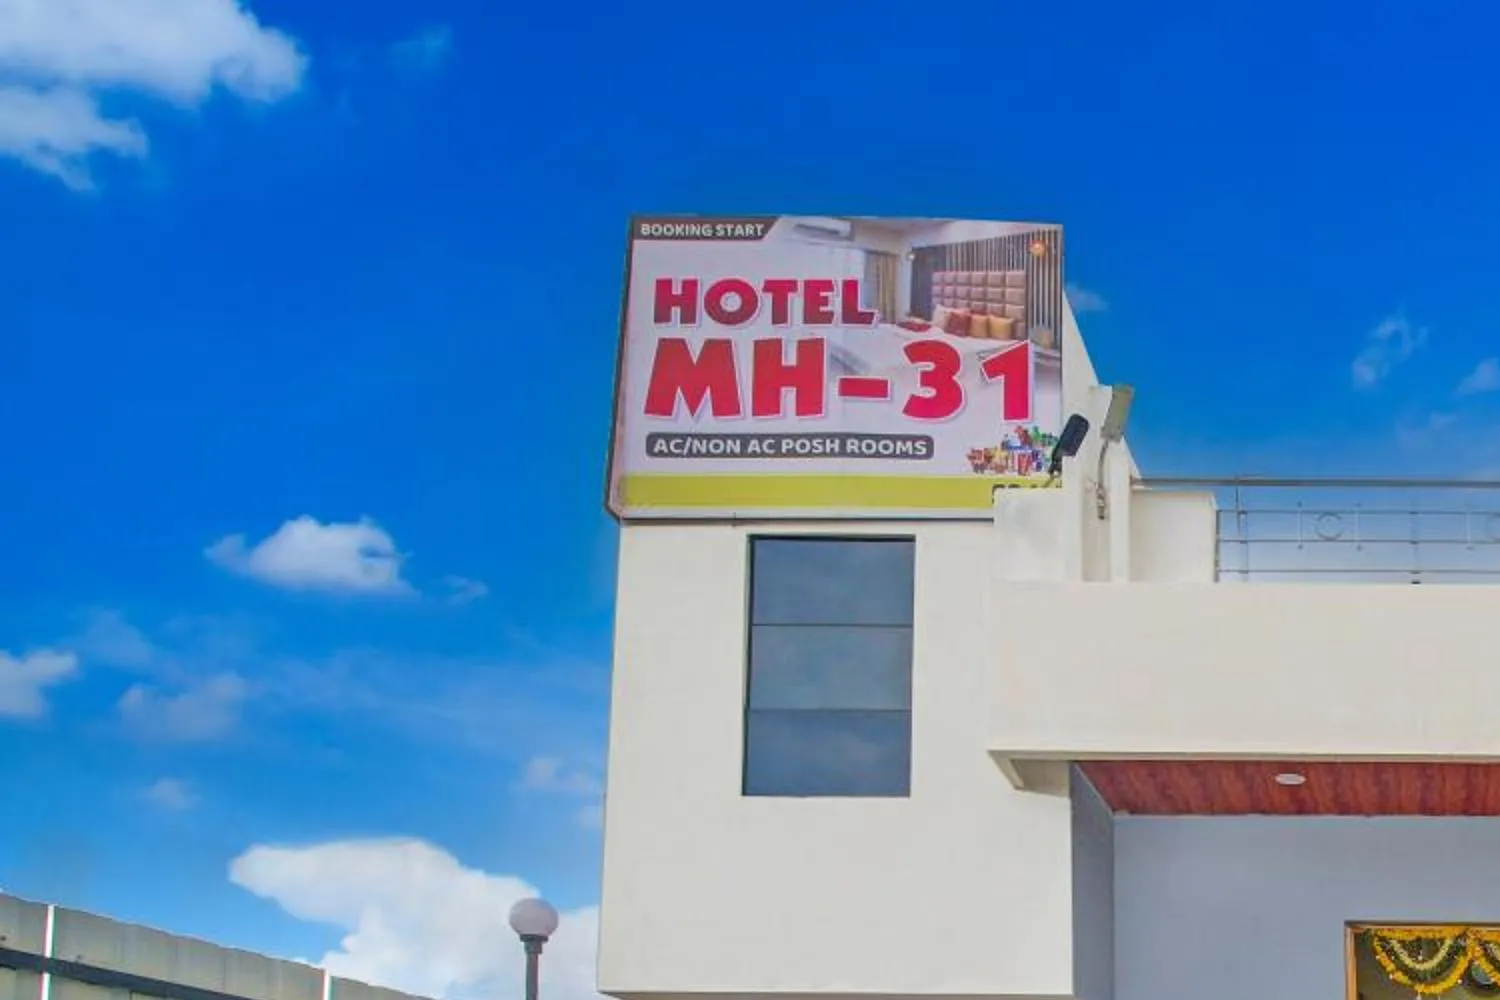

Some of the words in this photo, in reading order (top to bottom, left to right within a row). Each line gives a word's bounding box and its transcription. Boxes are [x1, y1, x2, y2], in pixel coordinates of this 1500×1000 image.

[640, 223, 712, 237] BOOKING
[714, 223, 765, 237] START
[653, 278, 878, 326] HOTEL
[644, 337, 1033, 421] MH-31
[653, 436, 741, 455] AC/NON
[747, 438, 776, 454] AC
[780, 438, 840, 454] POSH
[845, 438, 928, 455] ROOMS
